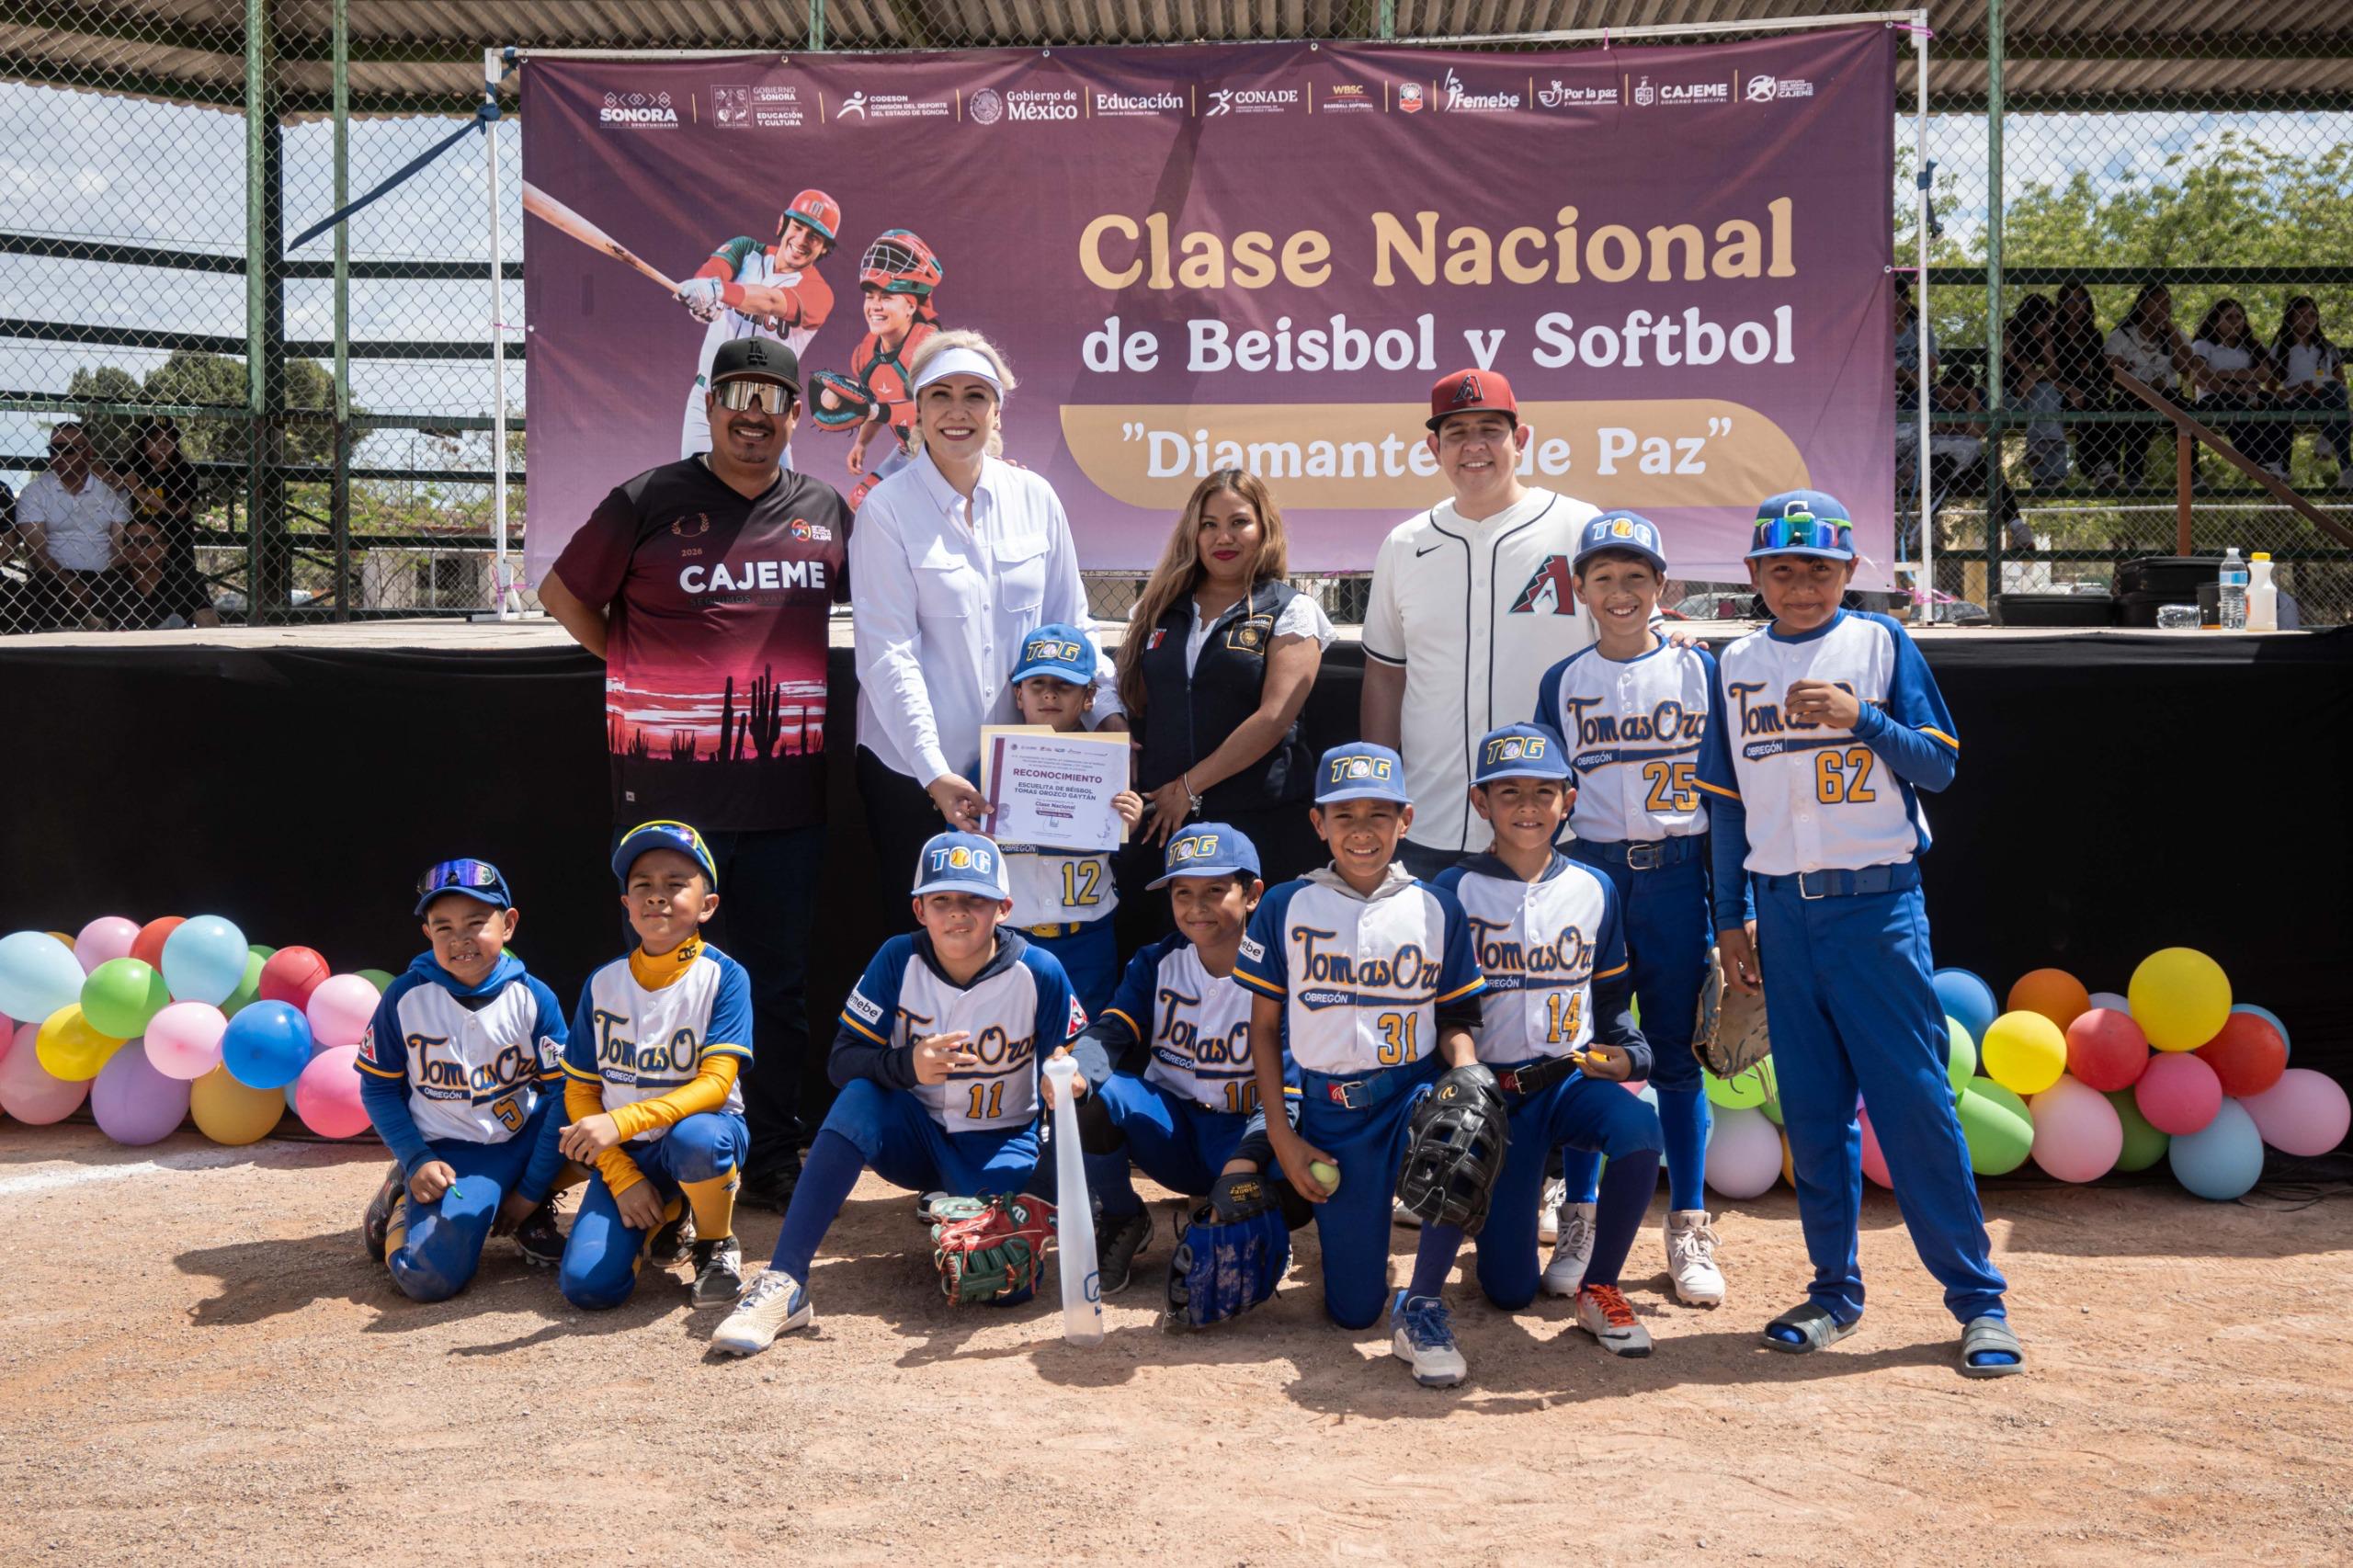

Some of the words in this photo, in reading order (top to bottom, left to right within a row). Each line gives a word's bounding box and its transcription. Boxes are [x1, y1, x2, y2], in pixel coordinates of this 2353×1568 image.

[753, 86, 796, 95] GOBIERNO
[1006, 90, 1061, 102] Gobierno
[1063, 89, 1077, 100] de
[1235, 89, 1298, 103] CONADE
[1333, 85, 1364, 95] WBSC
[1564, 88, 1584, 99] Por
[1586, 87, 1596, 98] la
[1597, 88, 1618, 100] paz
[1660, 84, 1728, 98] CAJEME
[1097, 92, 1184, 109] Educación
[1455, 92, 1520, 108] Femebe
[600, 108, 678, 121] SONORA
[756, 110, 803, 119] EDUCACIÓN
[1007, 101, 1078, 120] México
[1079, 211, 1332, 290] Clase
[1371, 197, 1797, 288] Nacional
[1082, 316, 1159, 373] de
[1187, 313, 1437, 372] Beisbol
[1532, 305, 1796, 369] Softbol
[681, 548, 703, 557] 2026
[679, 560, 826, 594] CAJEME
[1746, 741, 1783, 757] OBREGÓN
[1577, 751, 1612, 766] OBREGÓN
[1013, 767, 1103, 784] RECONOCIMIENTO
[1814, 746, 1876, 804] 62
[1017, 781, 1054, 790] ESCUELITA
[1643, 760, 1699, 812] 25
[1039, 790, 1067, 798] OROZCO
[1068, 792, 1097, 801] GAYTÁN
[1051, 801, 1075, 810] Nacional
[1062, 859, 1101, 906] 12
[1304, 991, 1348, 1004] OBREGÓN
[1546, 992, 1582, 1043] 14
[1377, 1011, 1418, 1065] 31
[424, 1087, 462, 1099] OBREGÓN
[966, 1080, 1005, 1119] 11
[492, 1096, 524, 1132] 5
